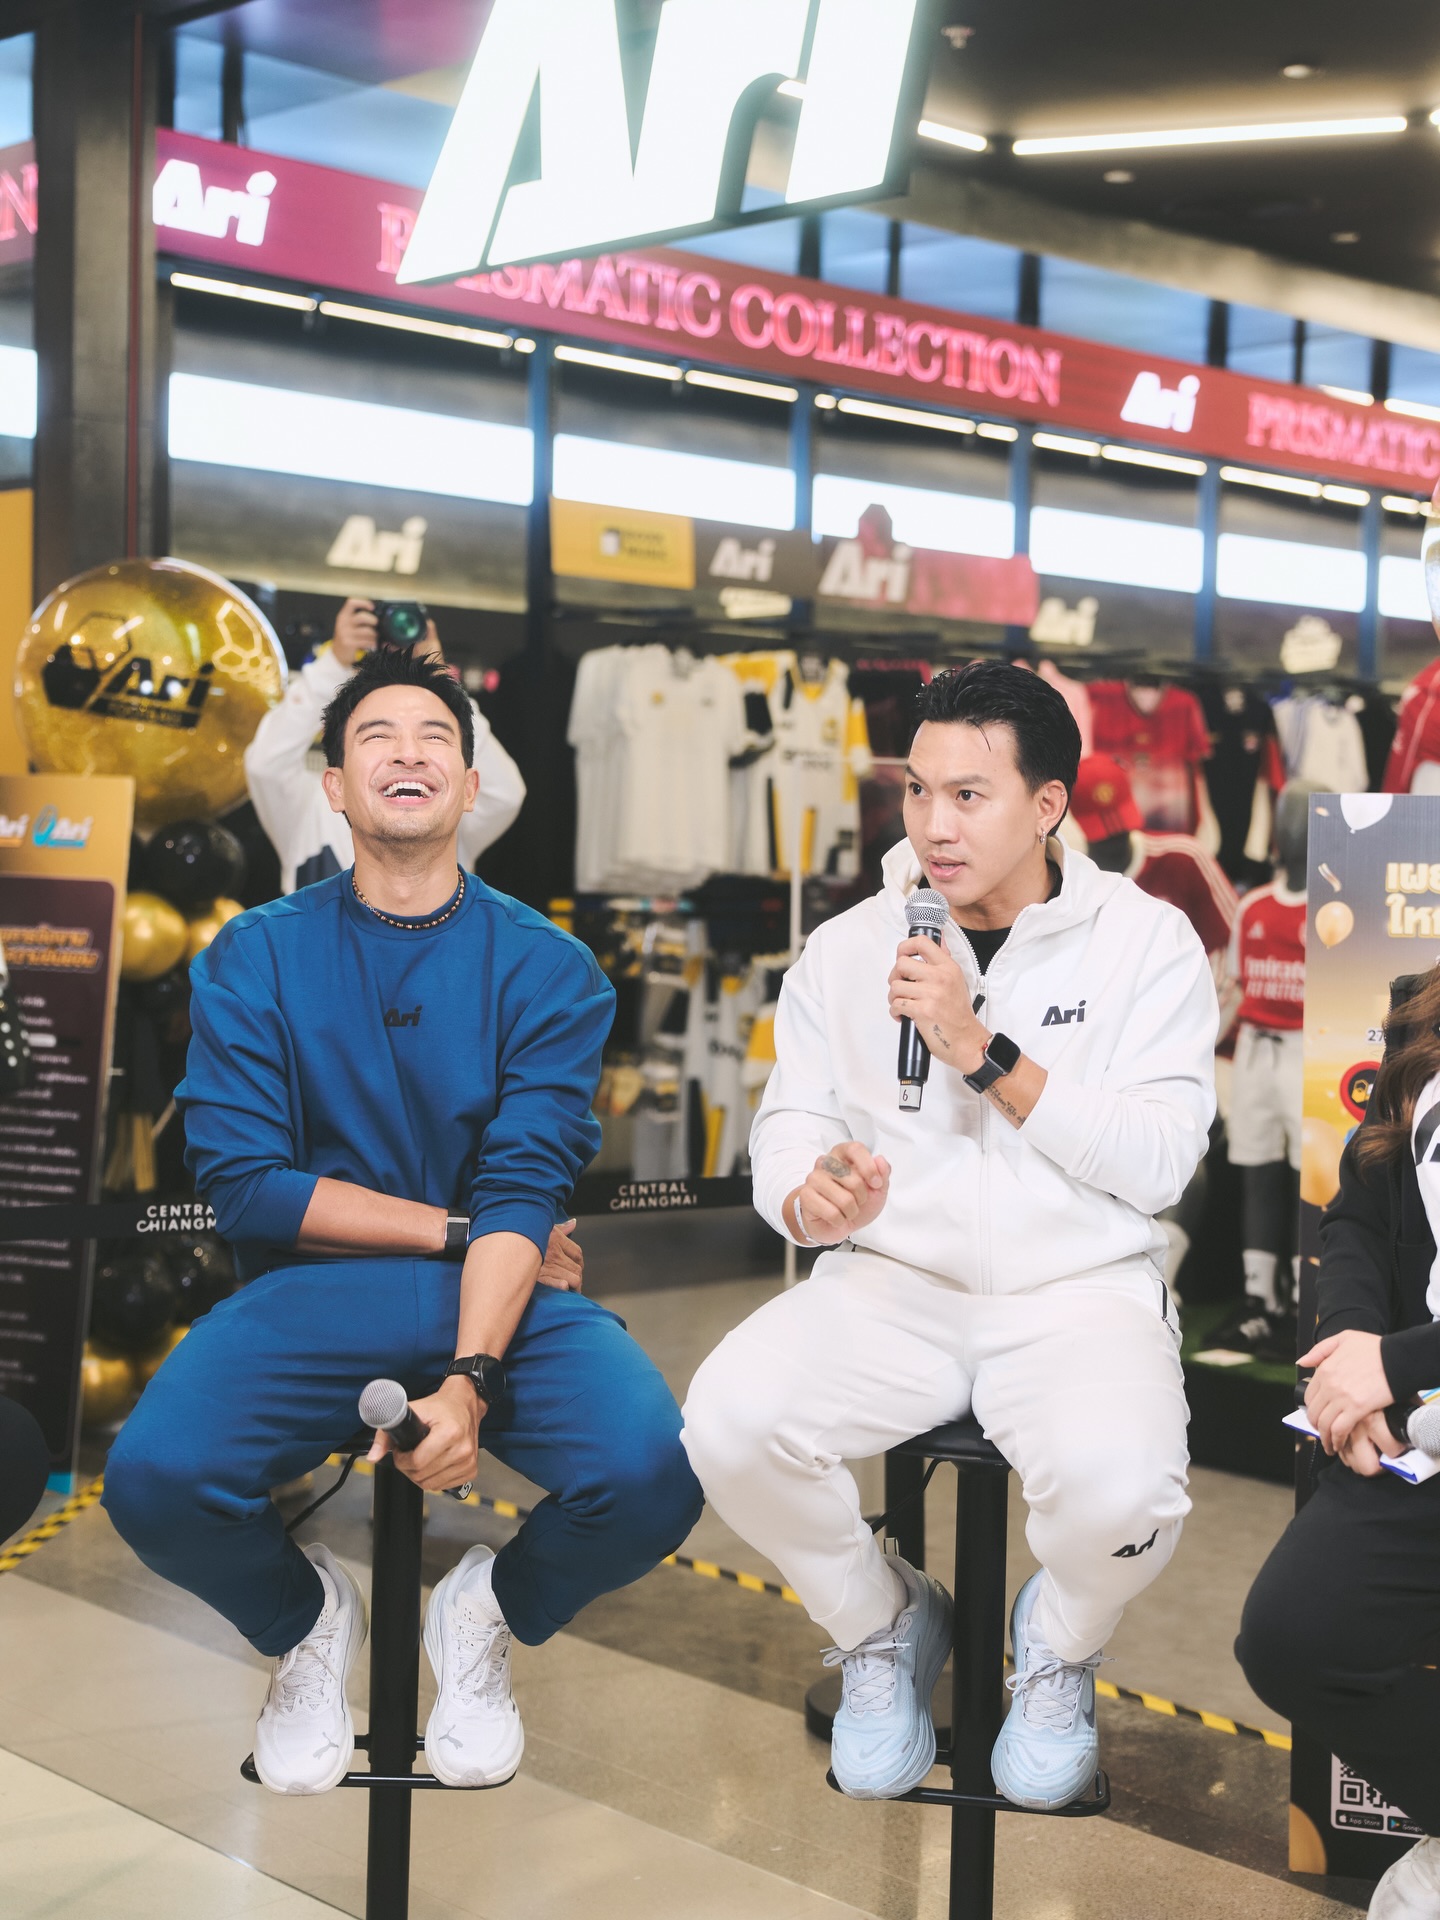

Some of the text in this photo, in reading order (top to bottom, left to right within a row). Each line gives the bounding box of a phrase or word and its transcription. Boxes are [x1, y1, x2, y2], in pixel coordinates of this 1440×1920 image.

[152, 158, 277, 246] Ari
[729, 283, 1062, 407] COLLECTION
[1120, 371, 1200, 433] Ari
[1246, 391, 1440, 479] PRISMATIC
[326, 514, 428, 575] Ari
[708, 537, 777, 583] Ari
[818, 540, 913, 603] Ari
[1029, 597, 1099, 646] Ari
[104, 657, 214, 708] Ari
[383, 1004, 422, 1027] Ari
[1041, 999, 1086, 1026] Ari
[902, 1089, 909, 1101] 6
[610, 1194, 698, 1211] CHIANGMAI
[618, 1182, 688, 1197] CENTRAL
